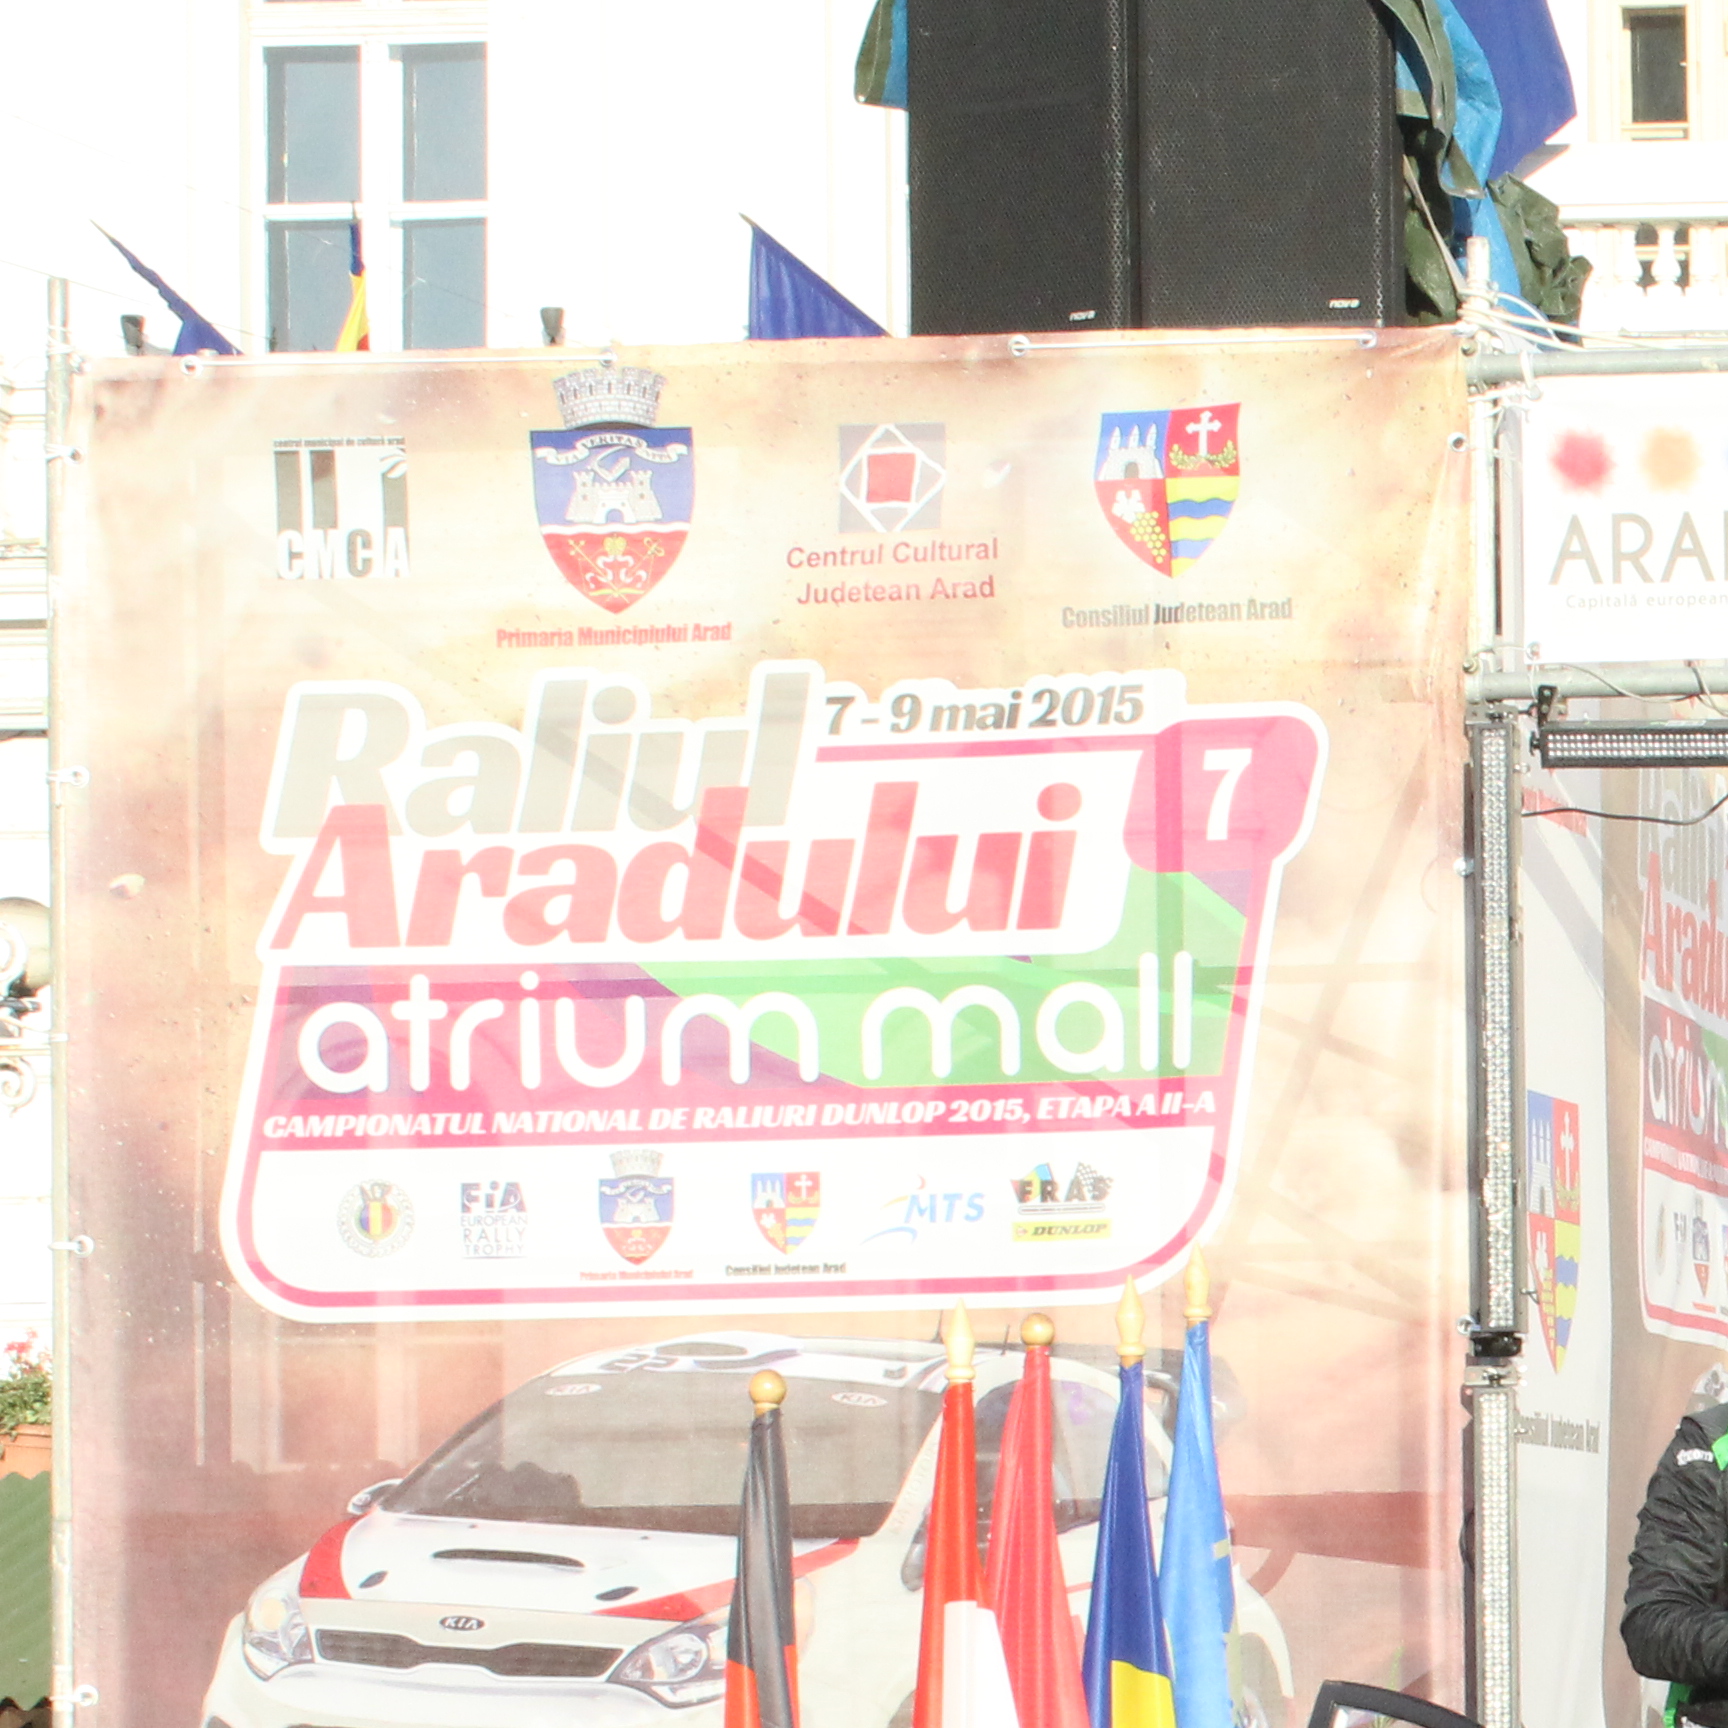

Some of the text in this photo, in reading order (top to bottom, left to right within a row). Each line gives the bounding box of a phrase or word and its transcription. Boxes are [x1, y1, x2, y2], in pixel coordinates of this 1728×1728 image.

[786, 538, 998, 570] Centrul Cultural
[930, 575, 995, 600] Arad
[496, 621, 732, 649] Primaria Municipiului Arad
[1061, 604, 1149, 628] Consiliul
[1246, 597, 1292, 621] Arad
[929, 683, 1144, 732] mai 2015
[271, 670, 811, 838] Raliul
[1201, 747, 1253, 841] 7
[268, 779, 1083, 950] Aradului
[297, 950, 1192, 1094] atrium mall
[263, 1111, 486, 1139] CAMPIONATUL
[492, 1107, 640, 1135] NATIONAL
[643, 1107, 689, 1132] DE
[693, 1102, 816, 1131] RALIURI
[820, 1099, 948, 1126] DUNLOP
[1036, 1093, 1132, 1120] ETAPA
